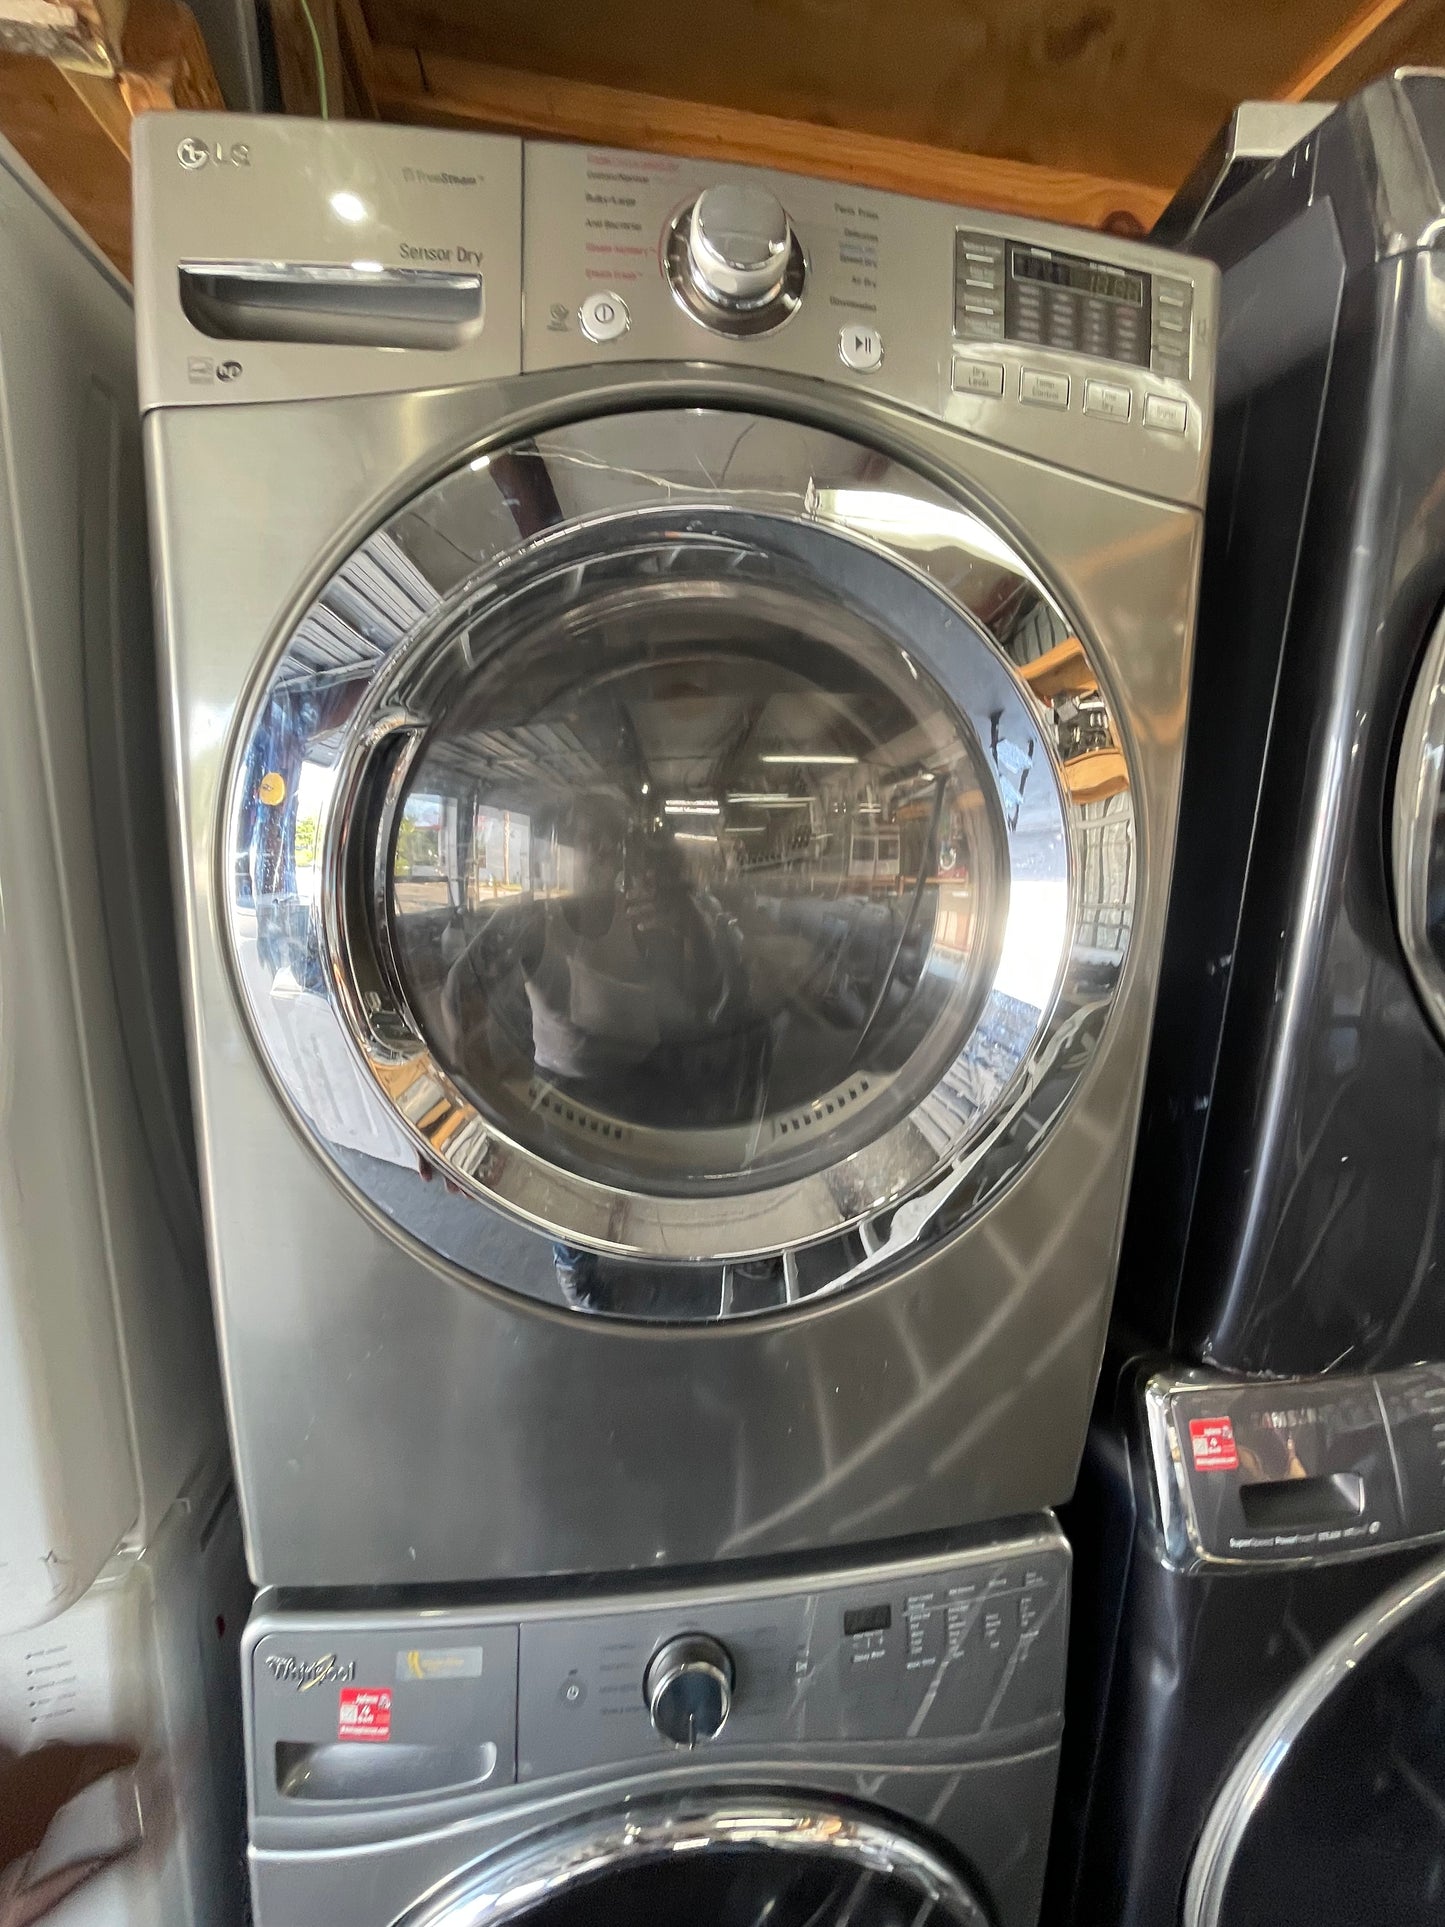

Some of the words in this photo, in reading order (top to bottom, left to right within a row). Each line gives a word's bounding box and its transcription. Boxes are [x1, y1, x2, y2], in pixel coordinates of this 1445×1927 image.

[400, 242, 451, 261] Sensor
[456, 246, 483, 266] Dry
[265, 1652, 356, 1692] Whirlpool
